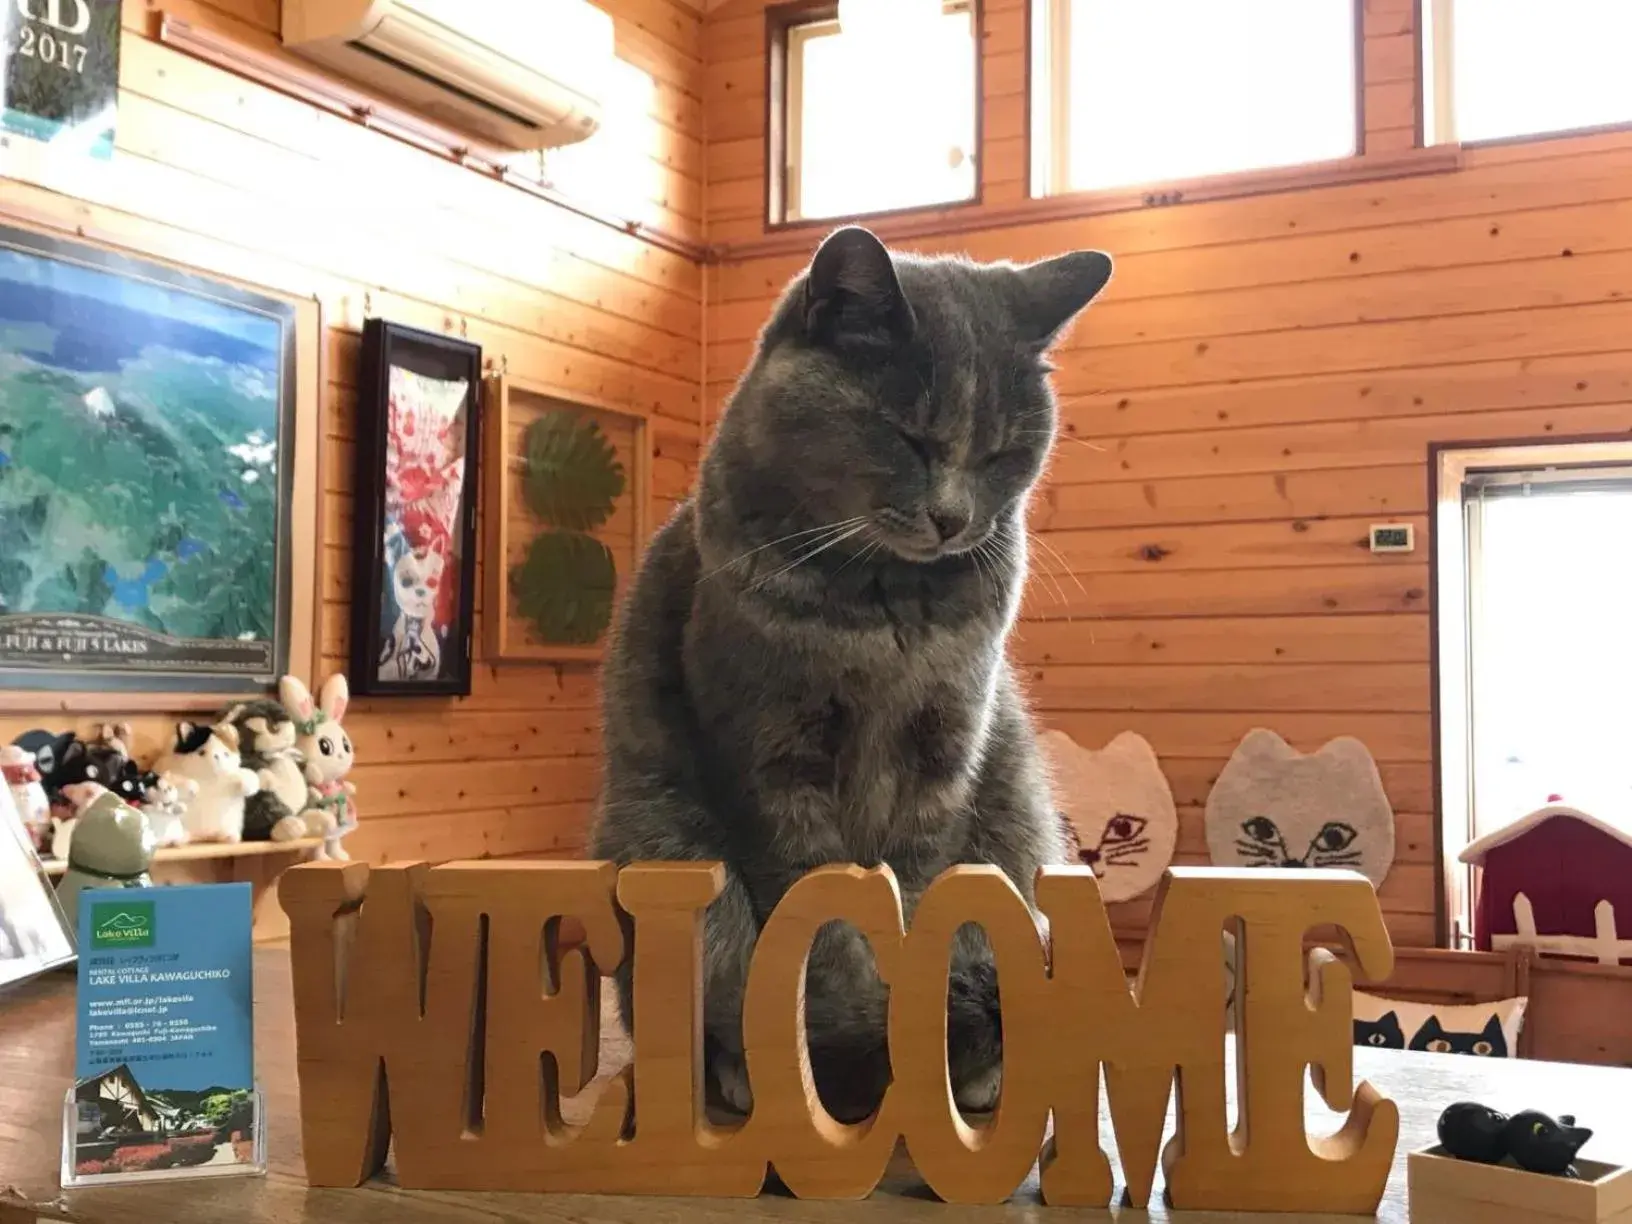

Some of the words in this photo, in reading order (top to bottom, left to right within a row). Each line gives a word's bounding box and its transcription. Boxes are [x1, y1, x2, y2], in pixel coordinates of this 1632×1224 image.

[19, 25, 88, 74] 2017
[89, 975, 116, 986] LAKE
[119, 974, 148, 984] VILLA
[150, 968, 231, 983] KAWAGUCHIKO
[278, 860, 1400, 1212] WELCOME
